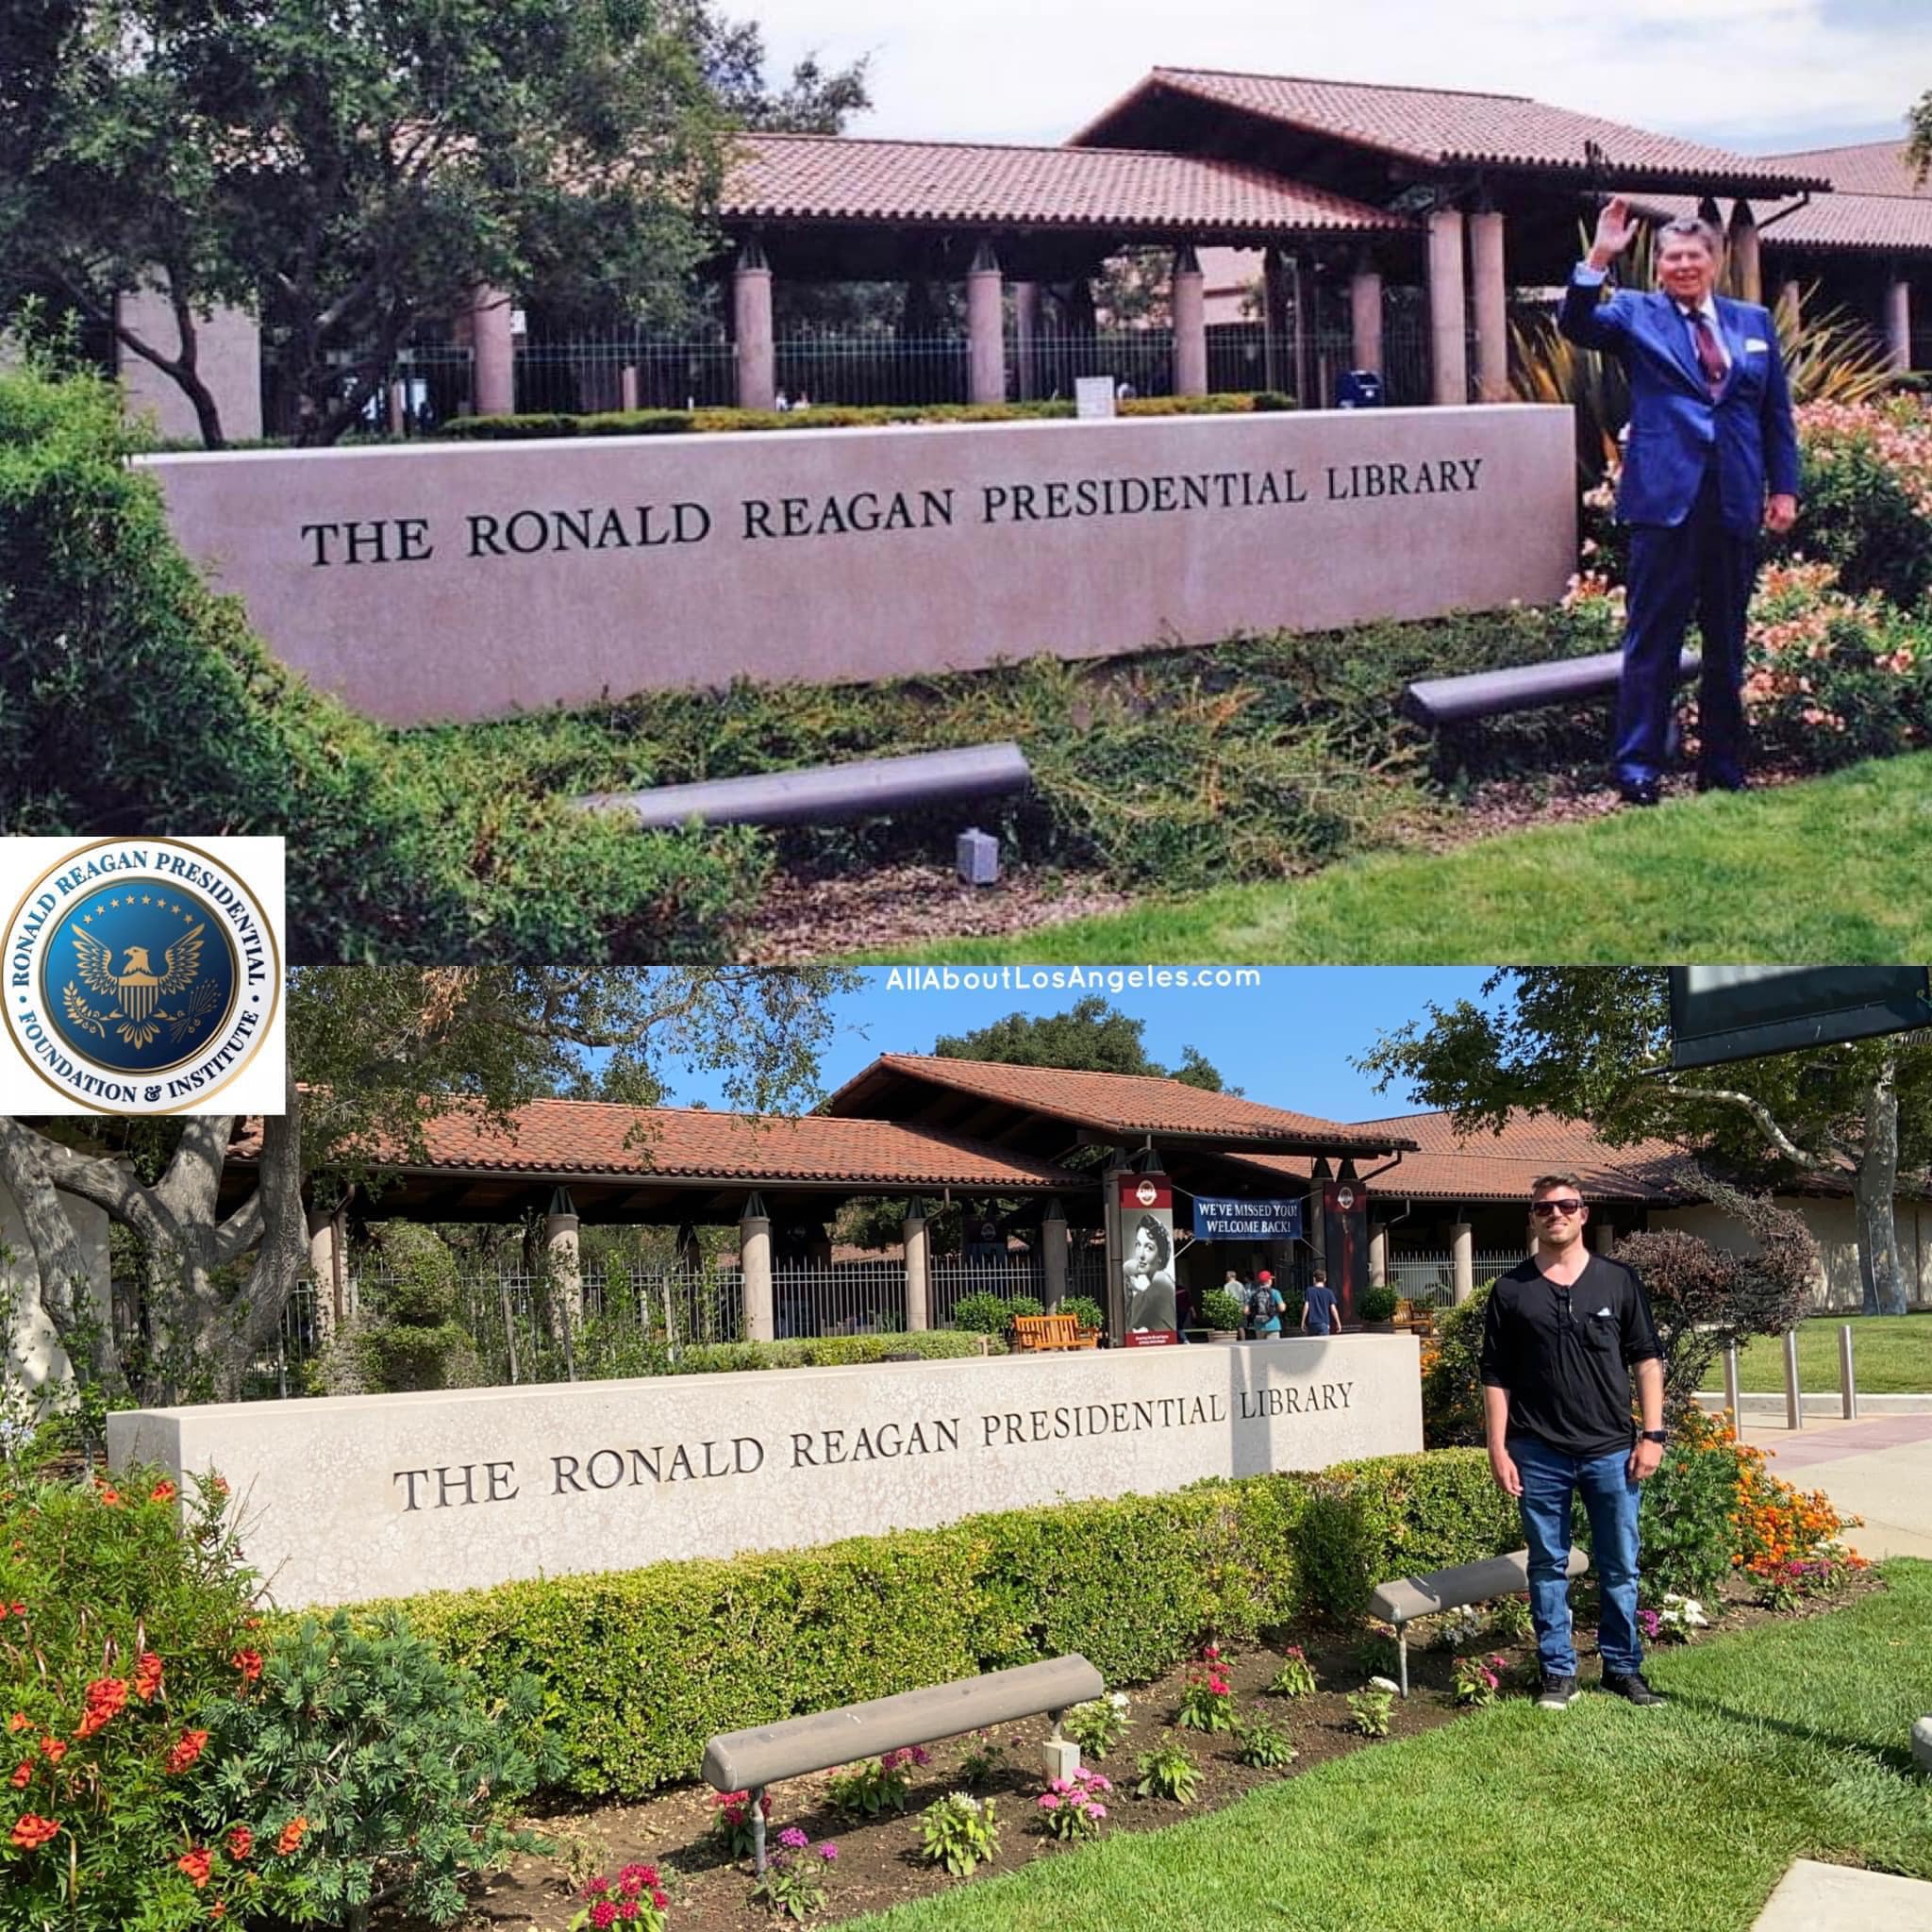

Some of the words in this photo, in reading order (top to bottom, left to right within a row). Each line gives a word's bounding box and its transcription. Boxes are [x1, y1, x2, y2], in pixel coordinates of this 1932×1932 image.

[302, 518, 434, 567] THE
[466, 502, 712, 558] RONALD
[741, 490, 955, 541] REAGAN
[981, 469, 1308, 525] PRESIDENTIAL
[1326, 458, 1484, 501] LIBRARY
[1198, 1203, 1233, 1216] WE'VE
[1234, 1204, 1272, 1217] MISSED
[1273, 1205, 1297, 1217] YOU!
[1207, 1221, 1260, 1233] WELCOME
[1261, 1221, 1291, 1233] BACK!
[393, 1460, 521, 1512] THE
[550, 1436, 765, 1495] RONALD
[790, 1418, 961, 1469] REAGAN
[981, 1393, 1226, 1448] PRESIDENTIAL
[1239, 1382, 1355, 1420] LIBRARY
